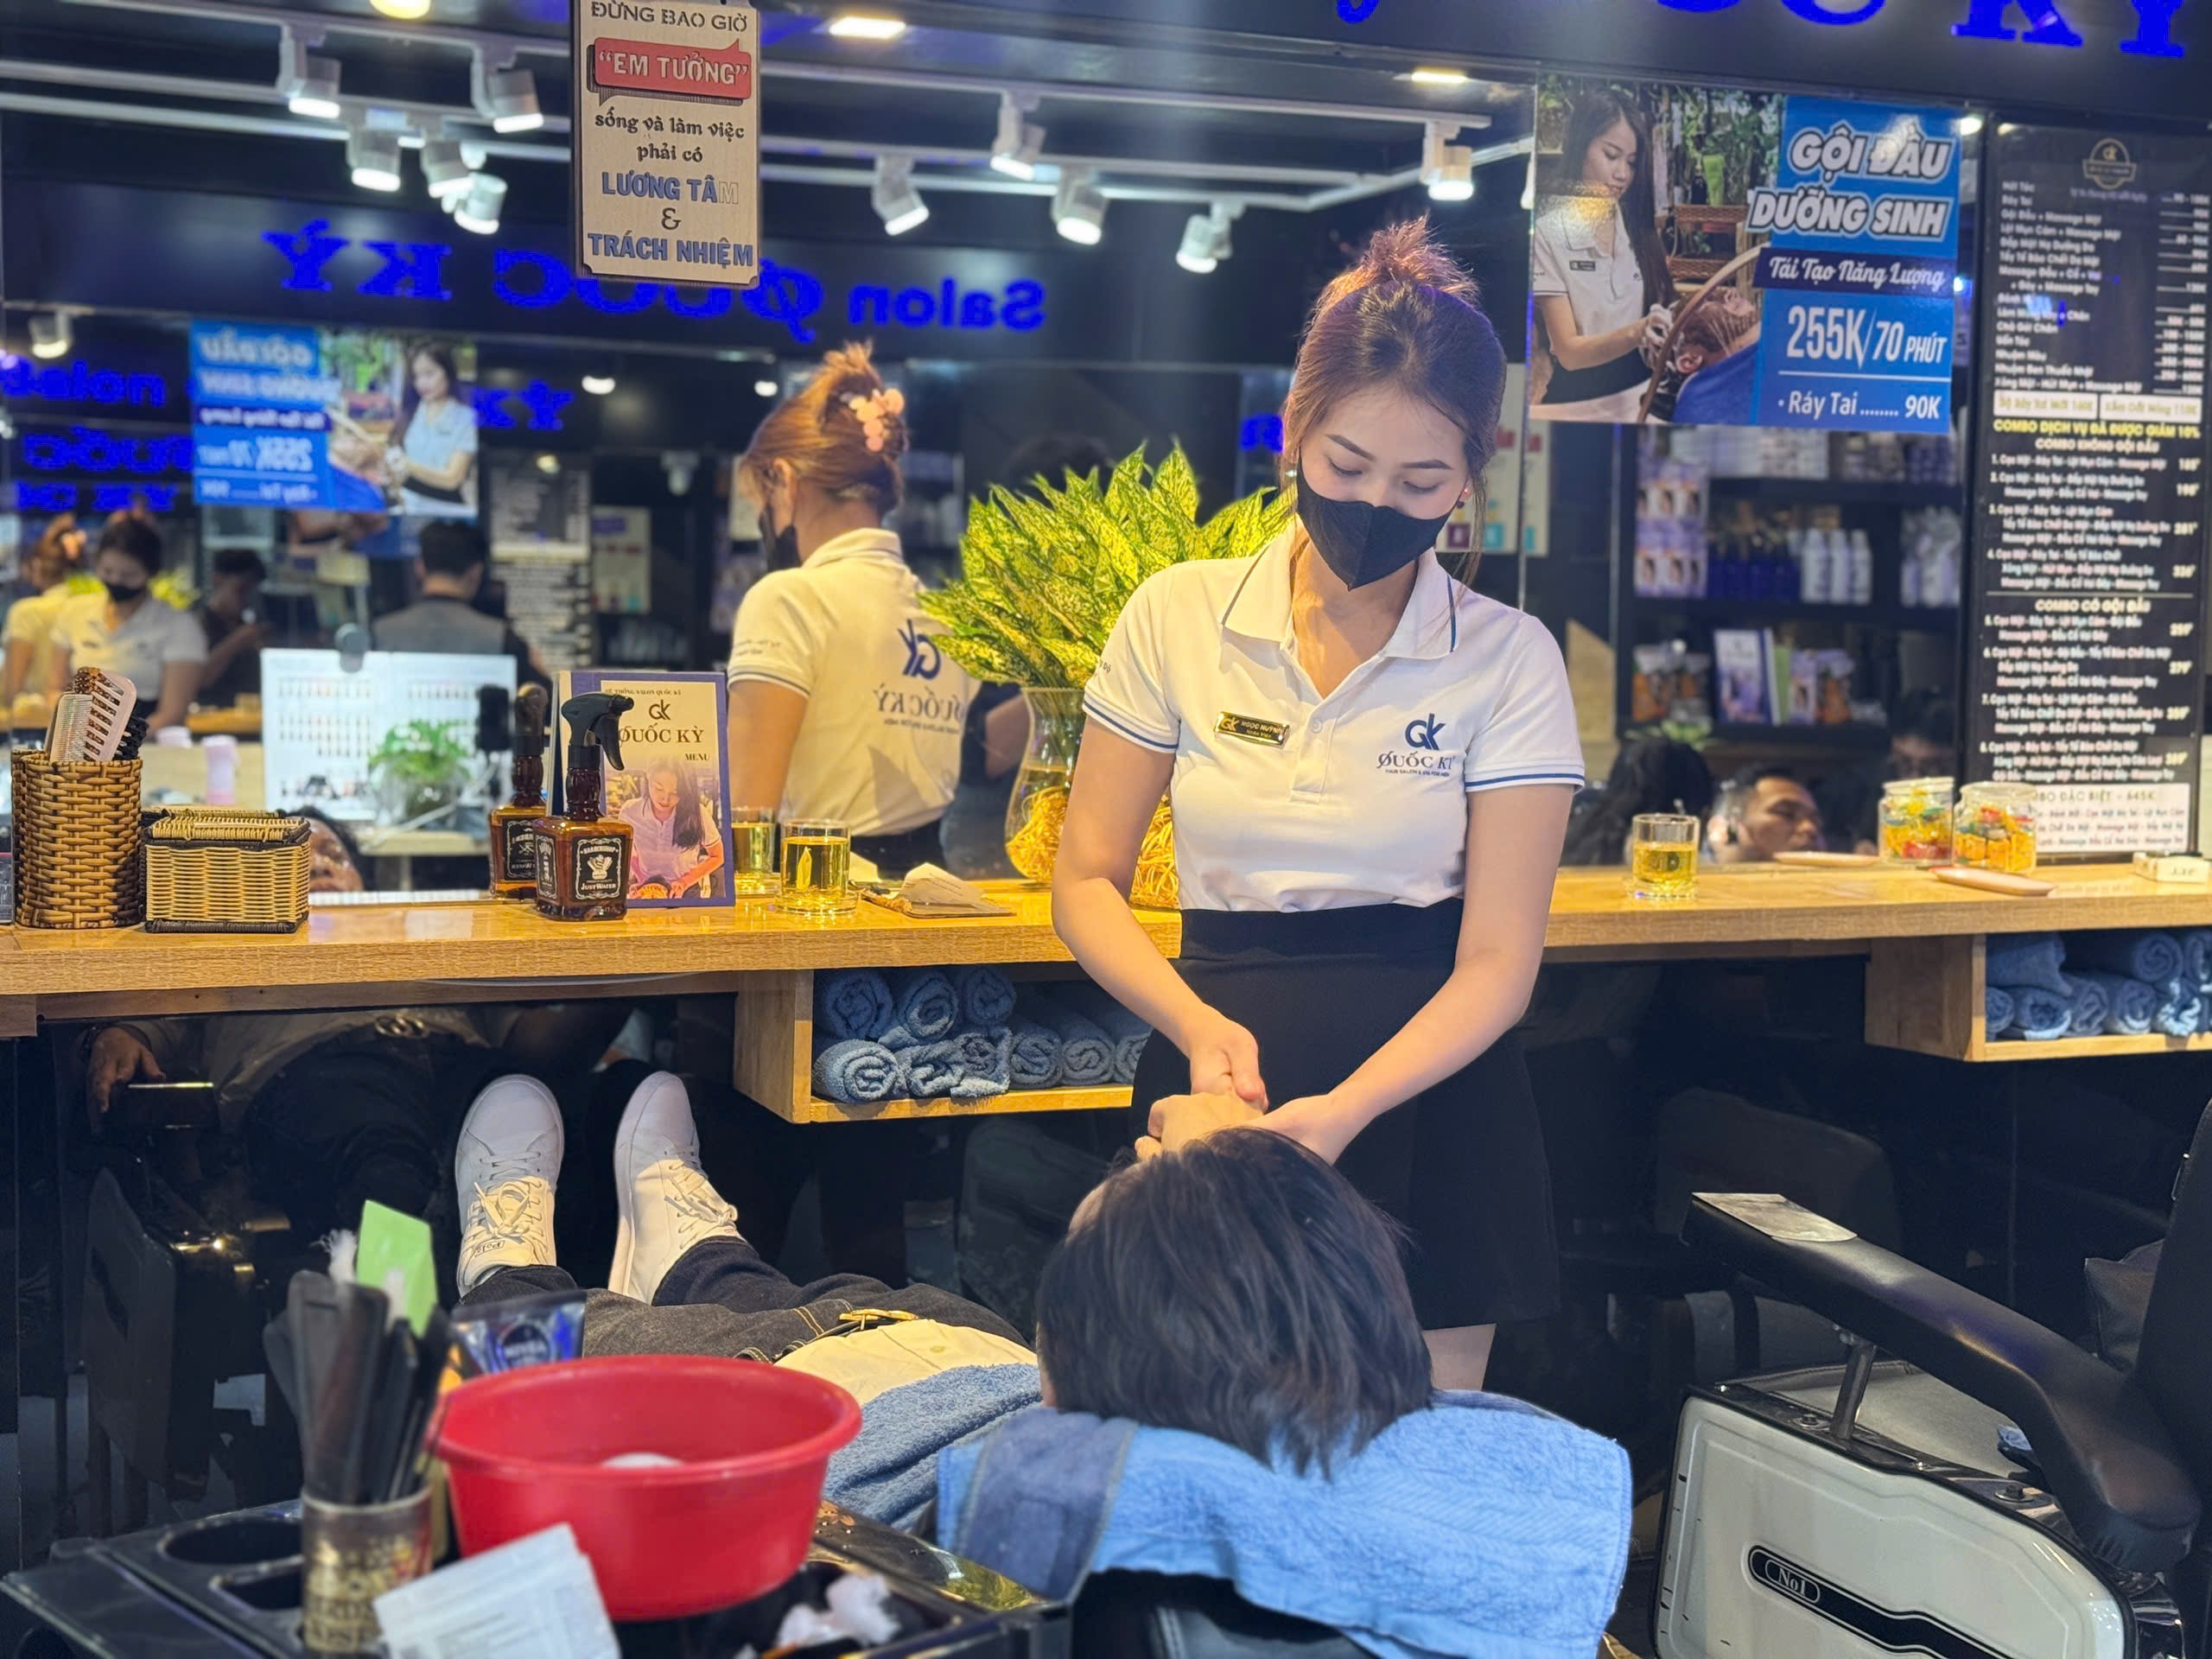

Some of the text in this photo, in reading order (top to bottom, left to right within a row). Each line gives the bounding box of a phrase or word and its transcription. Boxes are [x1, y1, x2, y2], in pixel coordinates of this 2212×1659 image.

[591, 0, 747, 32] ĐỪNG BAO GIỜ
[595, 106, 745, 143] sống và làm việc
[637, 143, 703, 162] phải có
[1790, 121, 1952, 182] GỘI ĐẦU
[602, 170, 739, 205] LƯƠNG TÂM
[661, 207, 681, 230] &
[1749, 184, 1952, 239] DƯỠNG SINH
[588, 231, 753, 268] TRÁCH NHIỆM
[1770, 256, 1945, 292] Tái Tạo Năng Lượng
[1904, 333, 1947, 365] PHÚT
[1788, 390, 1825, 419] Ráy
[1904, 395, 1942, 419] 90K
[677, 728, 704, 744] KỲ
[684, 753, 710, 762] MENU
[1777, 1567, 1807, 1597] No1
